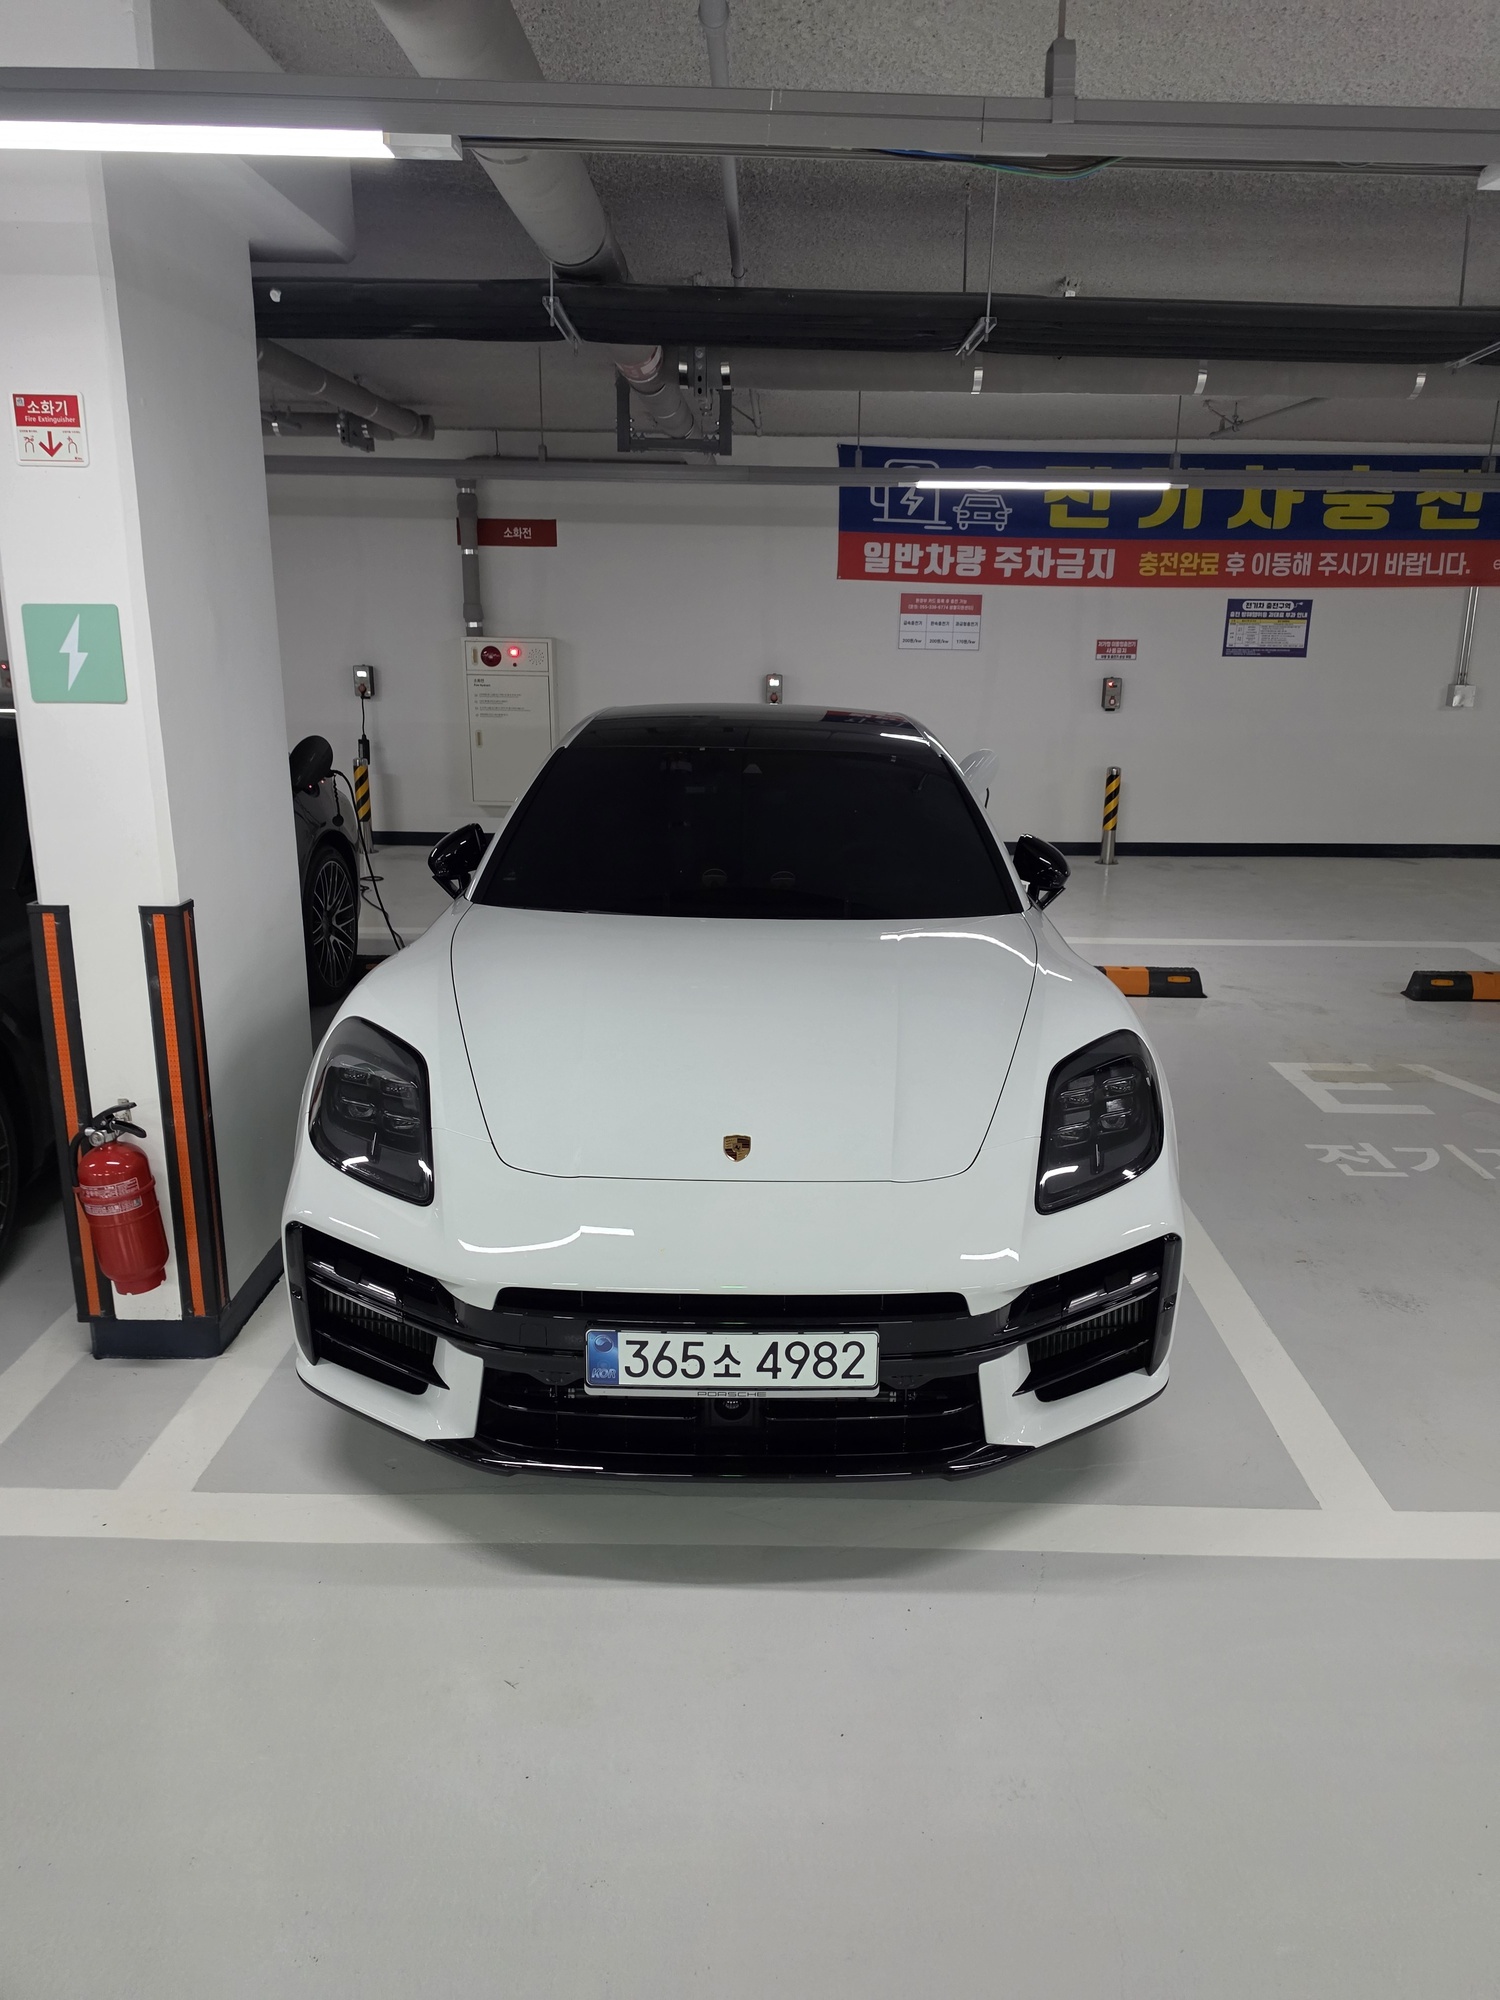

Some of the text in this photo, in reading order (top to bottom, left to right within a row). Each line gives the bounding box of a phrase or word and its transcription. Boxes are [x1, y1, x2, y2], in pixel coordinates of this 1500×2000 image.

[27, 400, 68, 416] 소화기
[24, 415, 76, 424] Fire Extinguisher
[503, 527, 532, 540] 소화전
[863, 541, 1116, 579] 일반차량 주차금지
[1138, 551, 1471, 577] 충전완료 후 이동해 주시기 바랍니다.
[624, 1340, 865, 1379] 365소 4982
[591, 1367, 617, 1379] KOR
